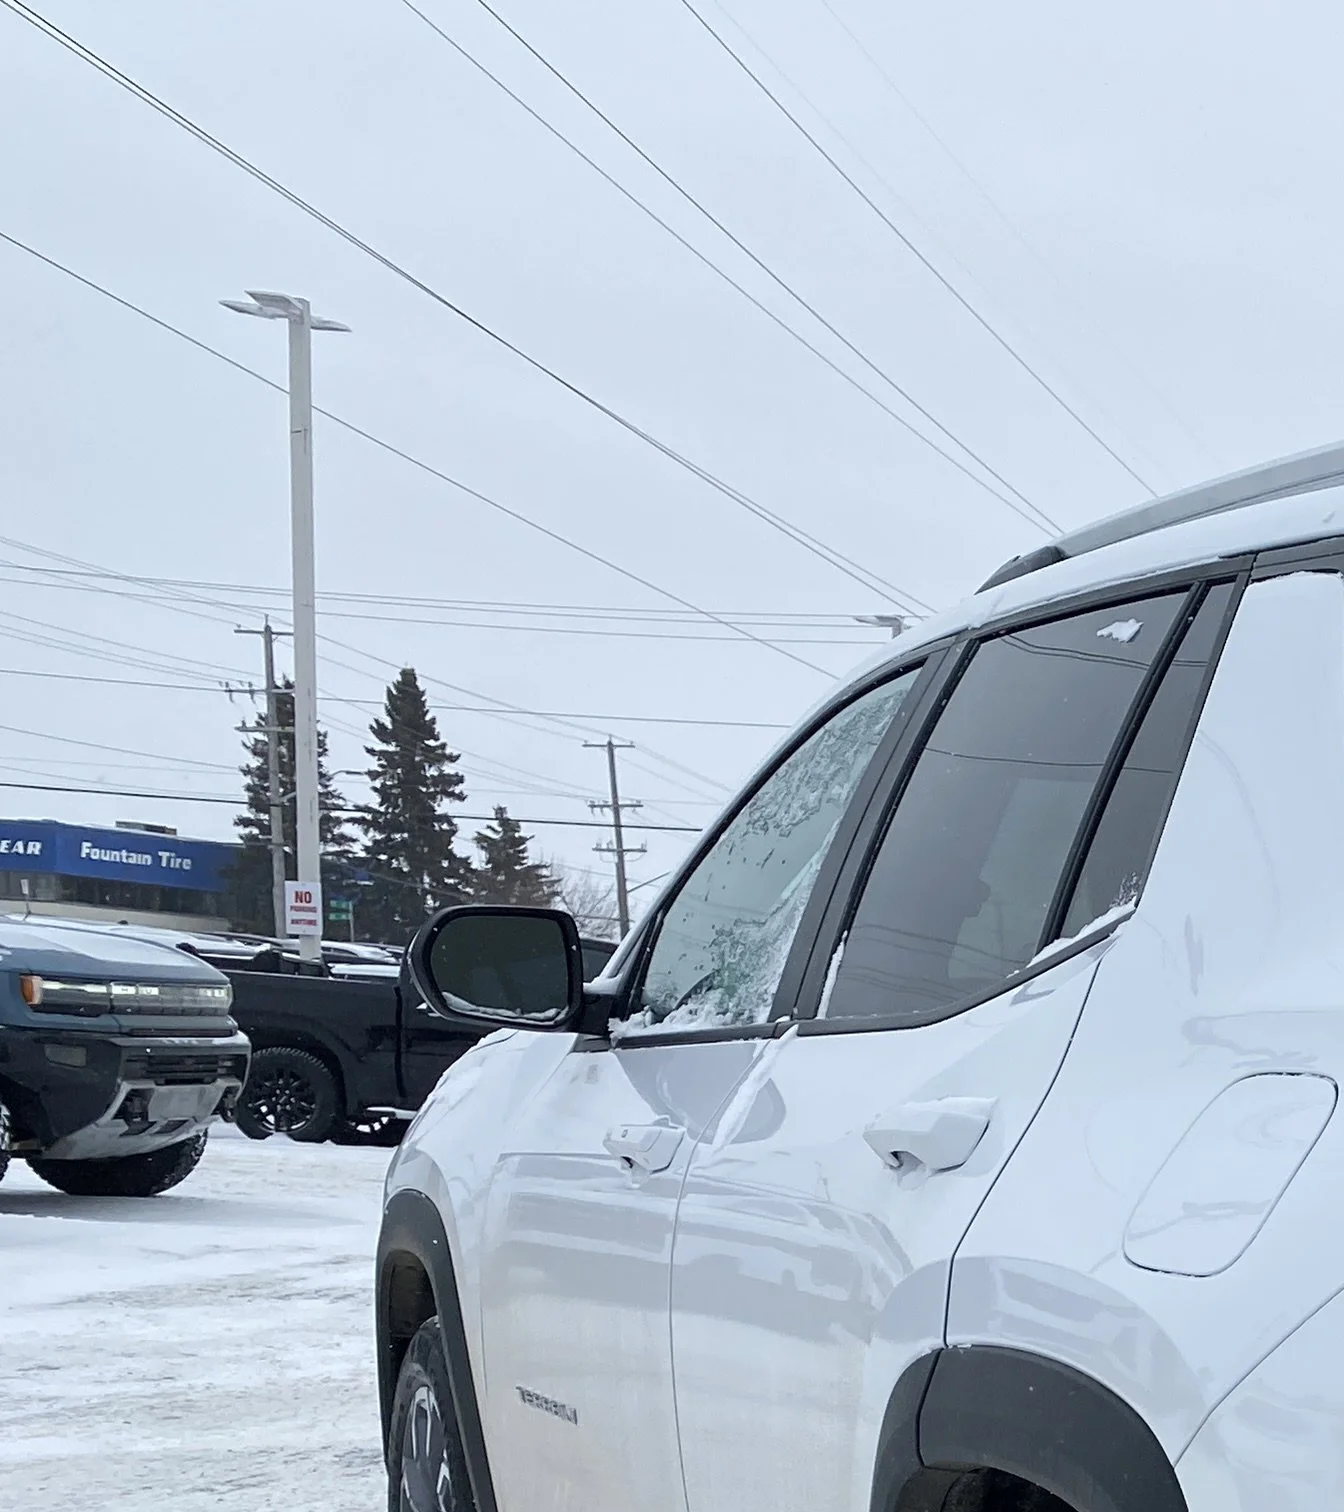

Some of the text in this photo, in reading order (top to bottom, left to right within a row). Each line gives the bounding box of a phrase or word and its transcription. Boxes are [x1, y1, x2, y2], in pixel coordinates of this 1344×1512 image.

[80, 841, 192, 870] Fountain Tire
[295, 890, 312, 904] NO
[515, 1386, 578, 1426] TERRAIN
